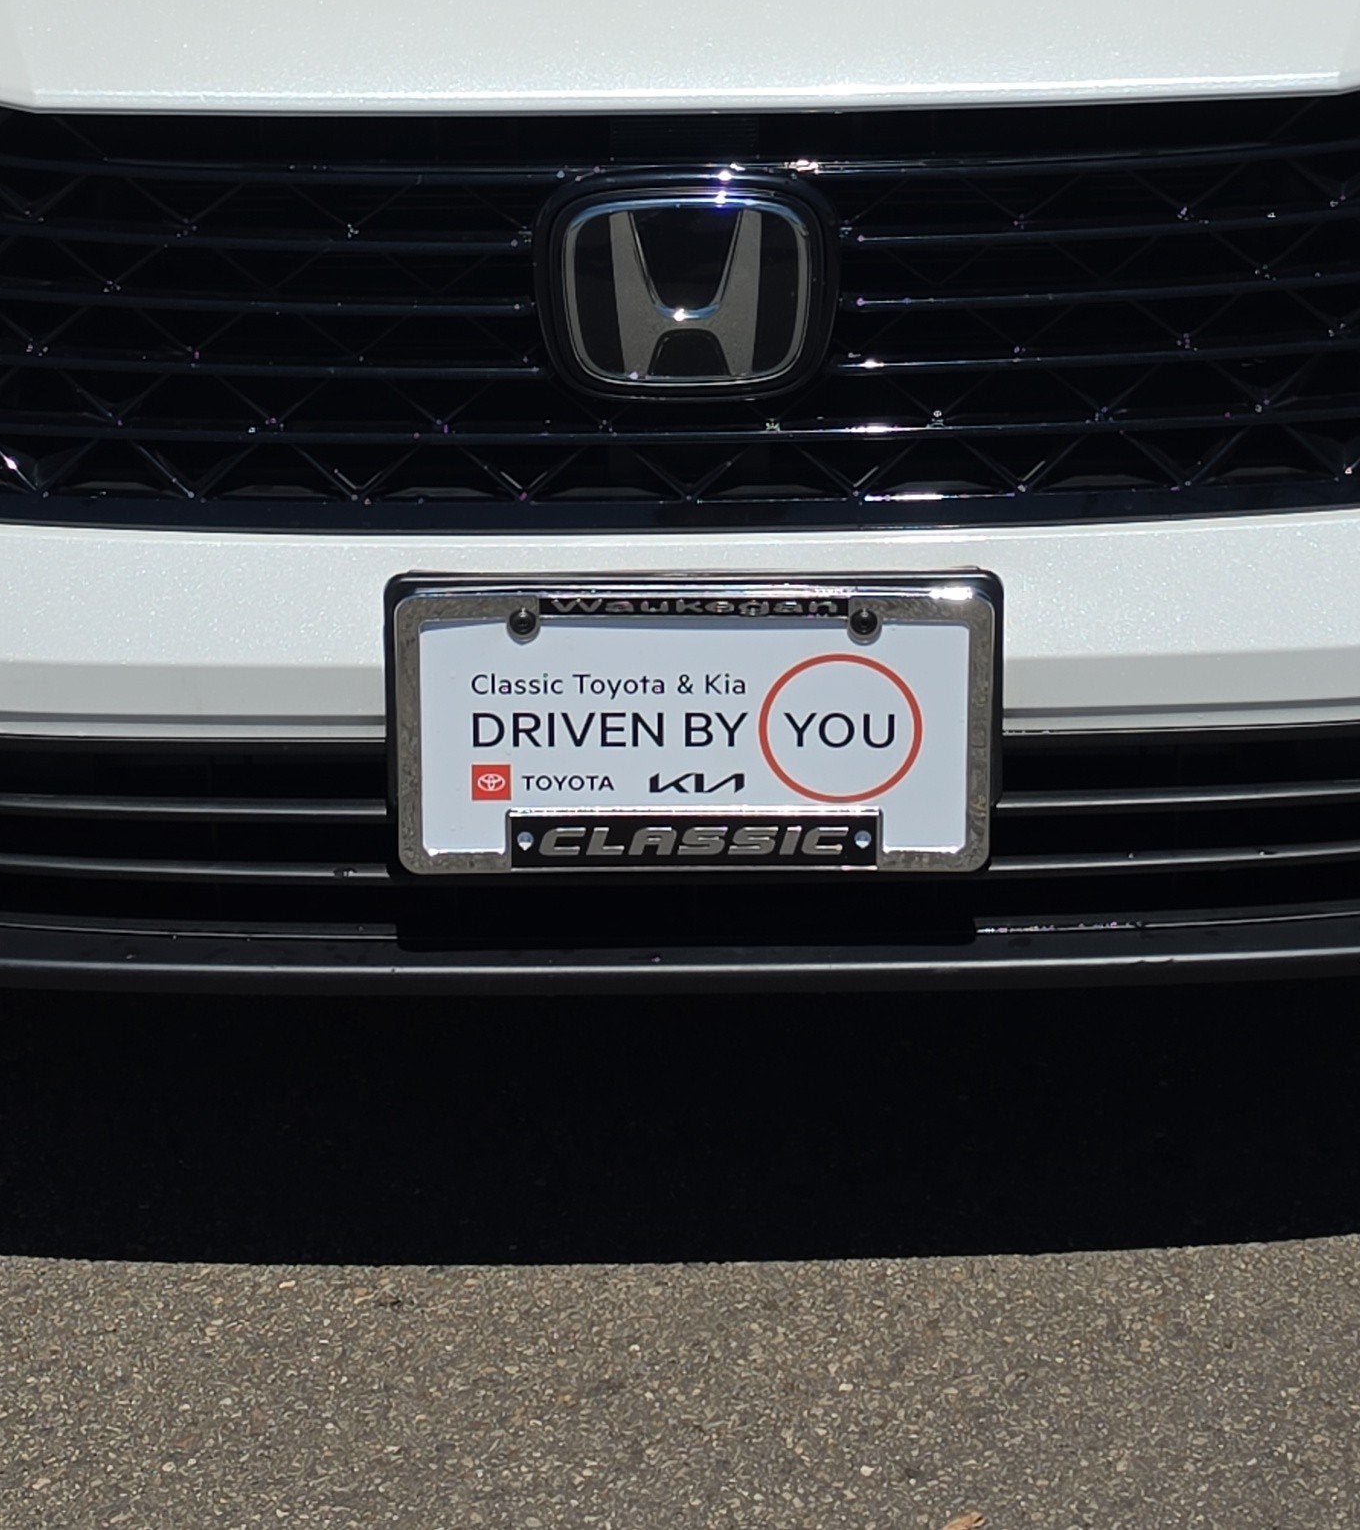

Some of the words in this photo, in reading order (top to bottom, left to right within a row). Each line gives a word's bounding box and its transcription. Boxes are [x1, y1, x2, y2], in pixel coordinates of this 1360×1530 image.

[471, 673, 564, 695] Classic
[572, 673, 665, 700] Toyota
[676, 673, 695, 696] &
[704, 672, 747, 696] Kia
[471, 711, 665, 748] DRIVEN
[683, 711, 749, 748] BY
[783, 711, 896, 749] YOU
[520, 774, 615, 792] TOYOTA
[538, 826, 850, 857] CLASSIC
